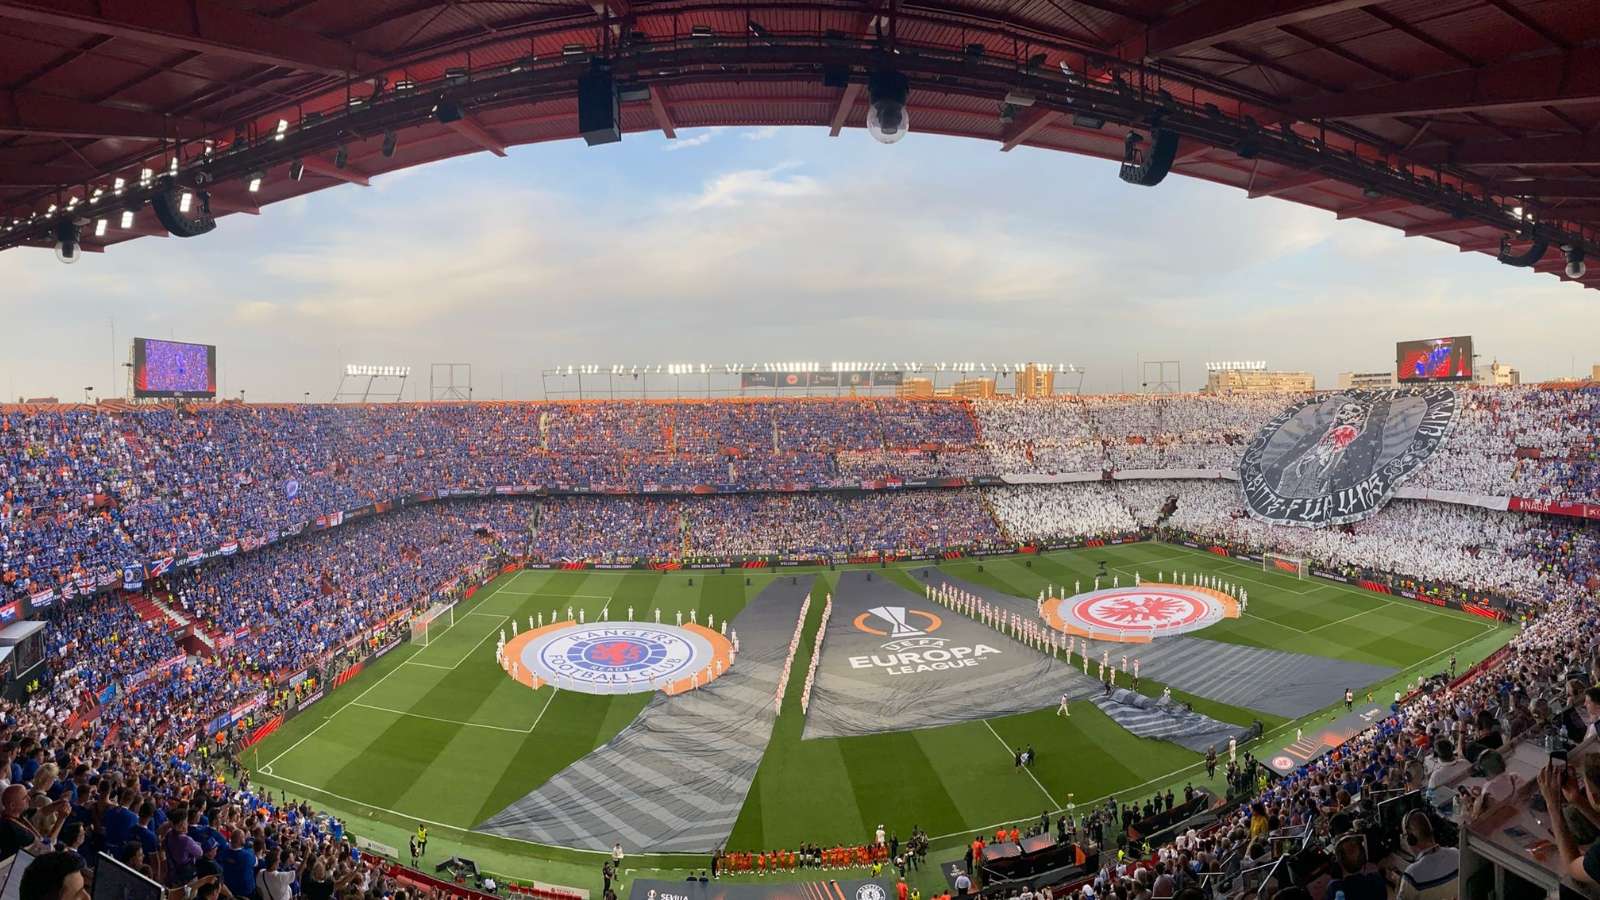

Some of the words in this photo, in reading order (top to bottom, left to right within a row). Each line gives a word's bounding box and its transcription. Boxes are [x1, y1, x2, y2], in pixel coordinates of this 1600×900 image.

[1246, 474, 1285, 515] BITTE
[1285, 495, 1333, 520] FÜR
[1338, 473, 1384, 514] UNS
[1524, 500, 1549, 512] NAGA
[570, 629, 679, 645] RANGERS
[886, 639, 945, 651] UEFA
[848, 644, 1002, 669] EUROPA
[550, 655, 633, 681] FOOTBALL
[640, 656, 683, 679] CLUB
[886, 658, 979, 676] LEAGUE
